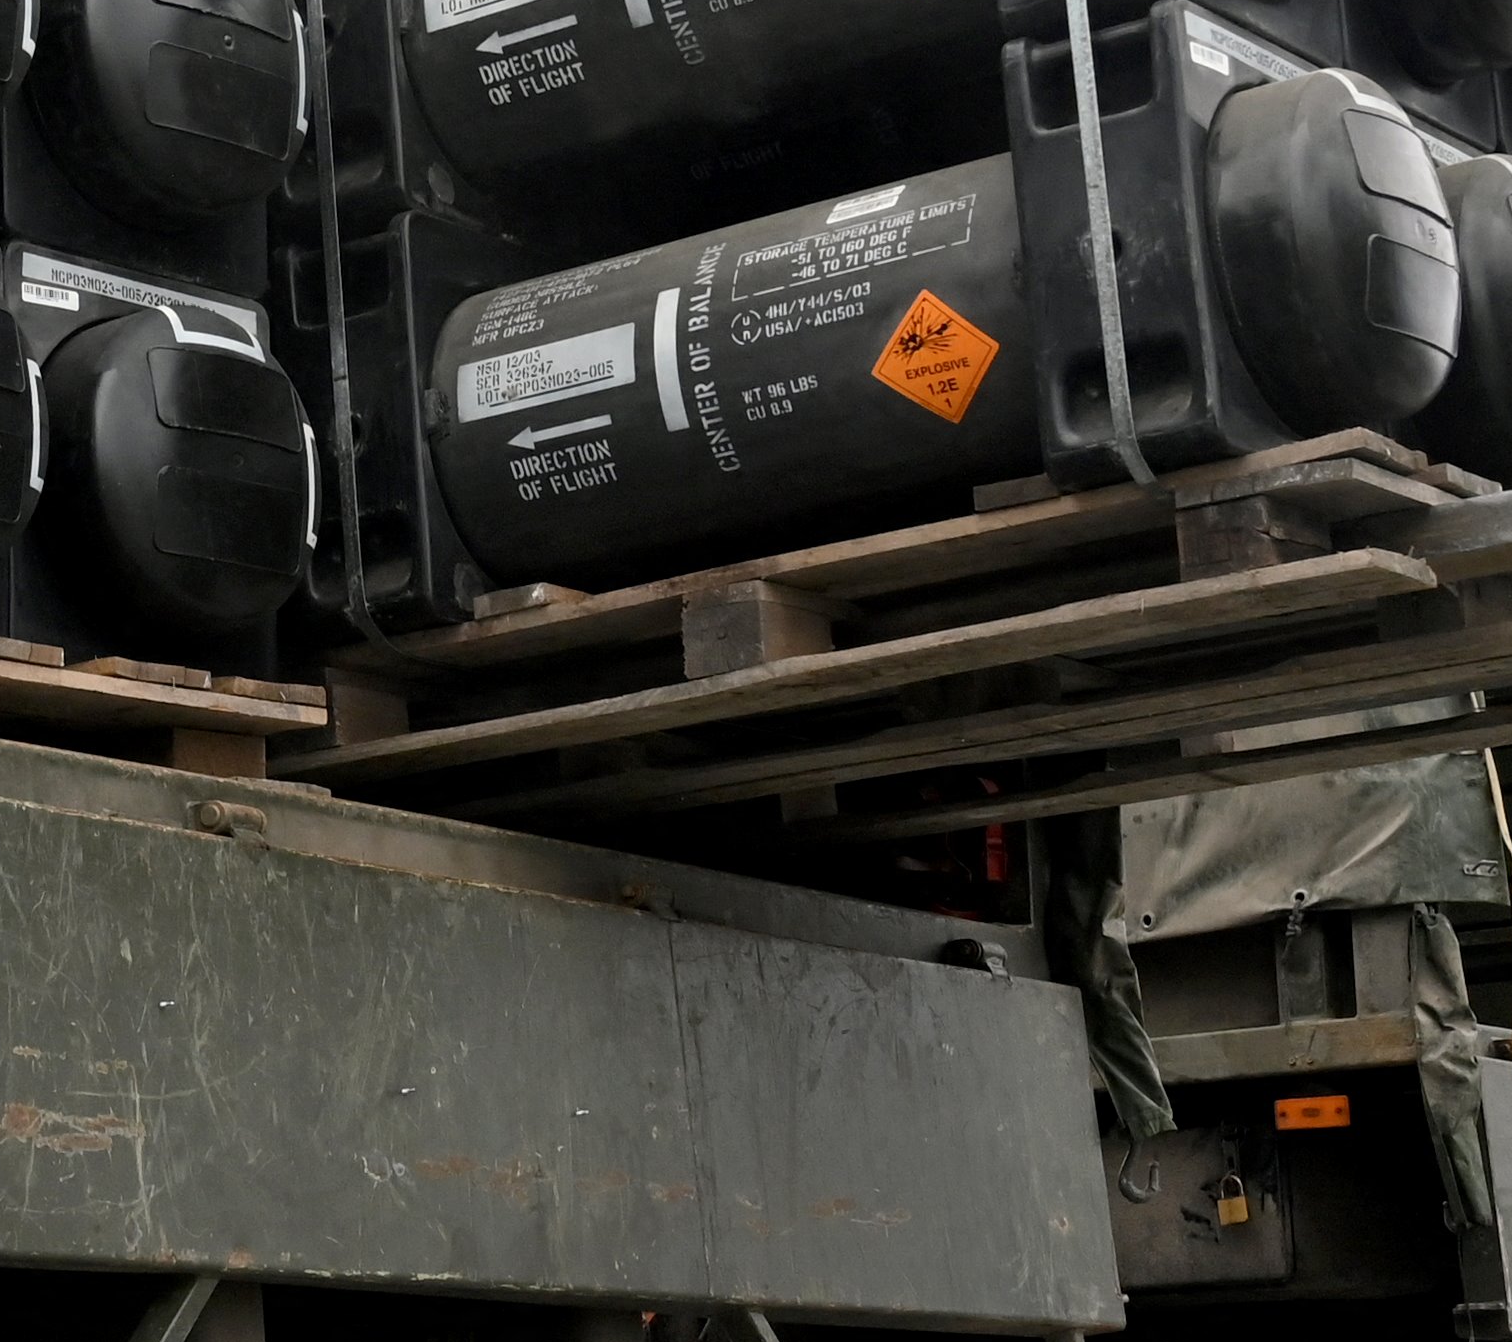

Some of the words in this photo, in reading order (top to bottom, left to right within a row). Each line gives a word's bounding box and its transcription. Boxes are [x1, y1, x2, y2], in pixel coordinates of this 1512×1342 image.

[478, 39, 578, 85] DIRECTION
[488, 85, 513, 107] OF
[519, 62, 585, 99] FLIGHT
[745, 239, 808, 266] STORAGE
[814, 211, 915, 248] TEMPERATURE
[919, 199, 966, 221] LIMITS
[791, 252, 811, 266] -51
[819, 246, 836, 261] TO
[841, 238, 865, 255] 160
[869, 231, 897, 247] DEG
[902, 225, 912, 239] F
[791, 265, 816, 279] -46
[823, 258, 840, 274] TO
[846, 253, 859, 267] 71
[864, 245, 892, 263] DEG
[897, 241, 907, 254] C
[687, 242, 726, 331] BALANCE
[481, 299, 537, 321] SURFACE
[472, 332, 498, 347] MFR
[506, 350, 541, 369] 12/03
[688, 341, 711, 372] OF
[905, 357, 970, 380] EXPLOSIVE
[476, 374, 500, 391] SER
[507, 360, 554, 384] 326247
[742, 388, 762, 405] WT
[767, 382, 786, 399] 96
[790, 374, 819, 394] LBS
[927, 378, 959, 396] 1.2E
[477, 389, 501, 406] LOT
[746, 404, 767, 421] CU
[771, 399, 794, 416] 8.9
[945, 398, 952, 409] 1
[695, 380, 741, 472] CENTER
[510, 439, 611, 480] DIRECTION
[519, 480, 543, 502] OF
[550, 462, 618, 495] FLIGHT
